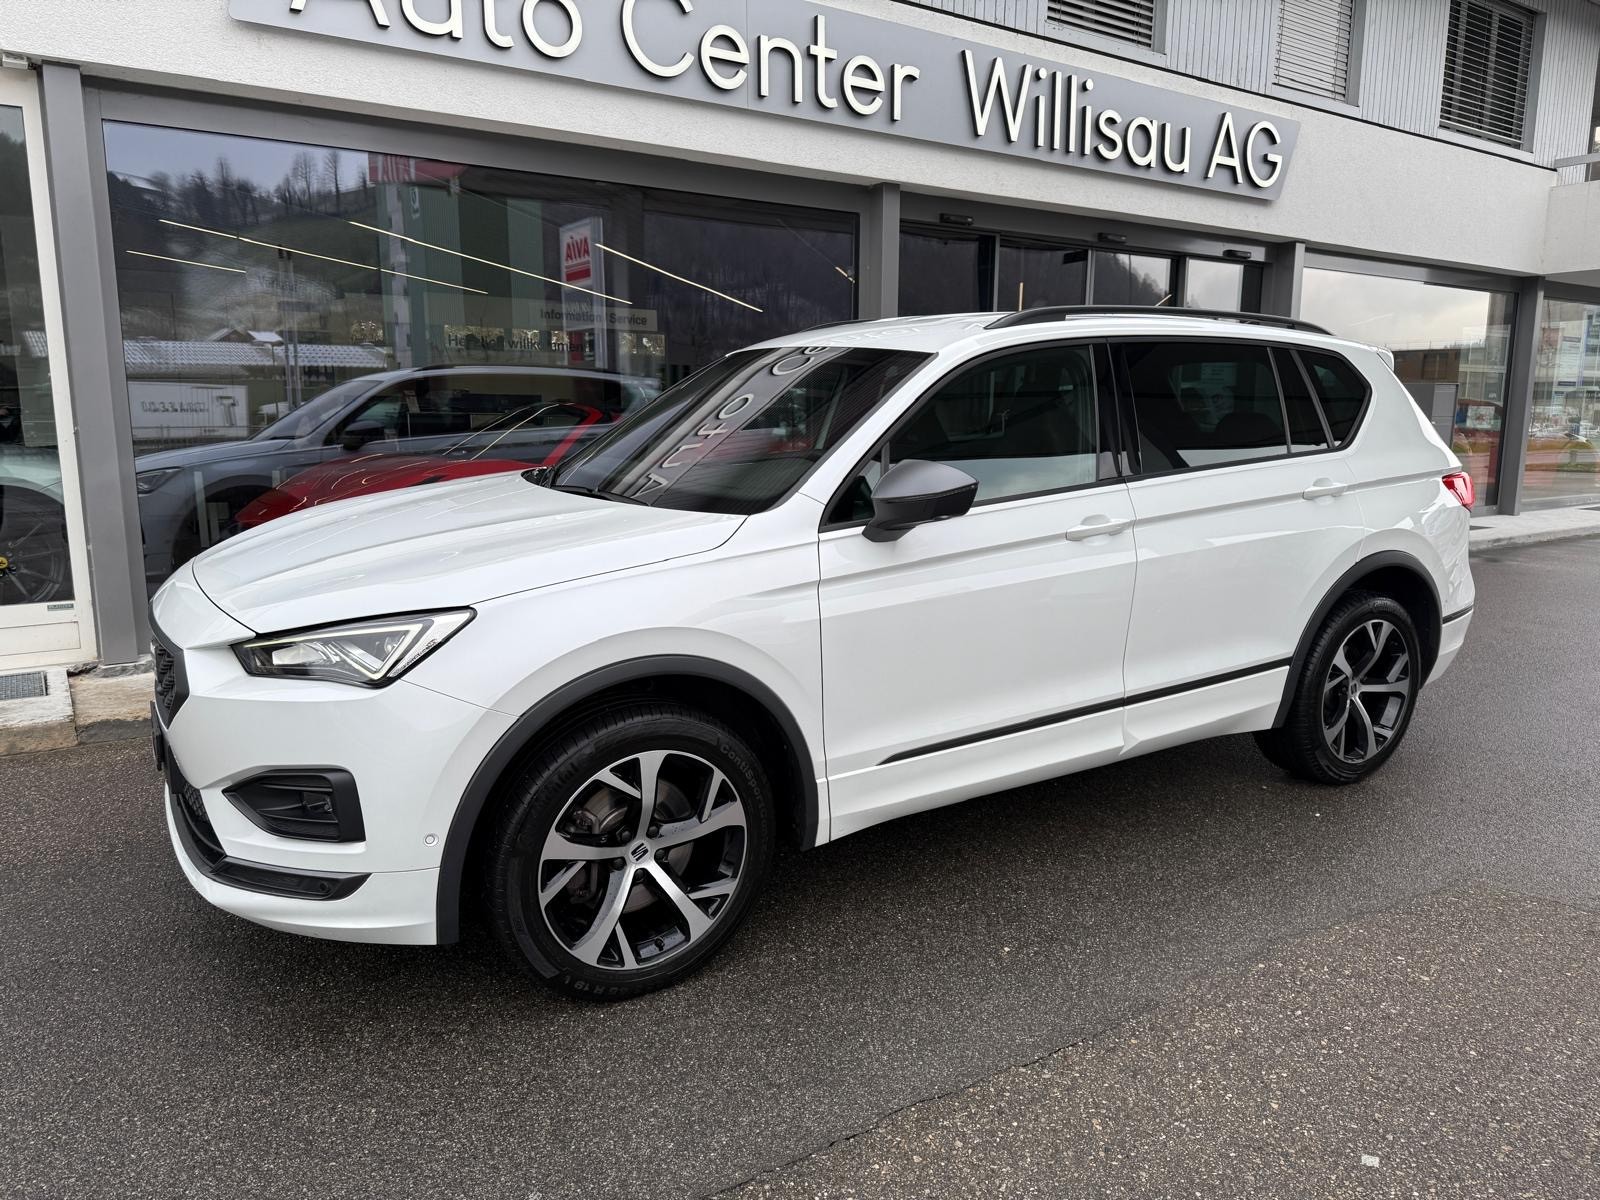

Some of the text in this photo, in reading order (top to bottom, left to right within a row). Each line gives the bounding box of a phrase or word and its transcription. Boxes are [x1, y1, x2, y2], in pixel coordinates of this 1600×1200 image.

[288, 0, 1283, 188] uo Center Willisau AG
[540, 309, 648, 326] Information Service
[507, 335, 584, 352] willkmmen
